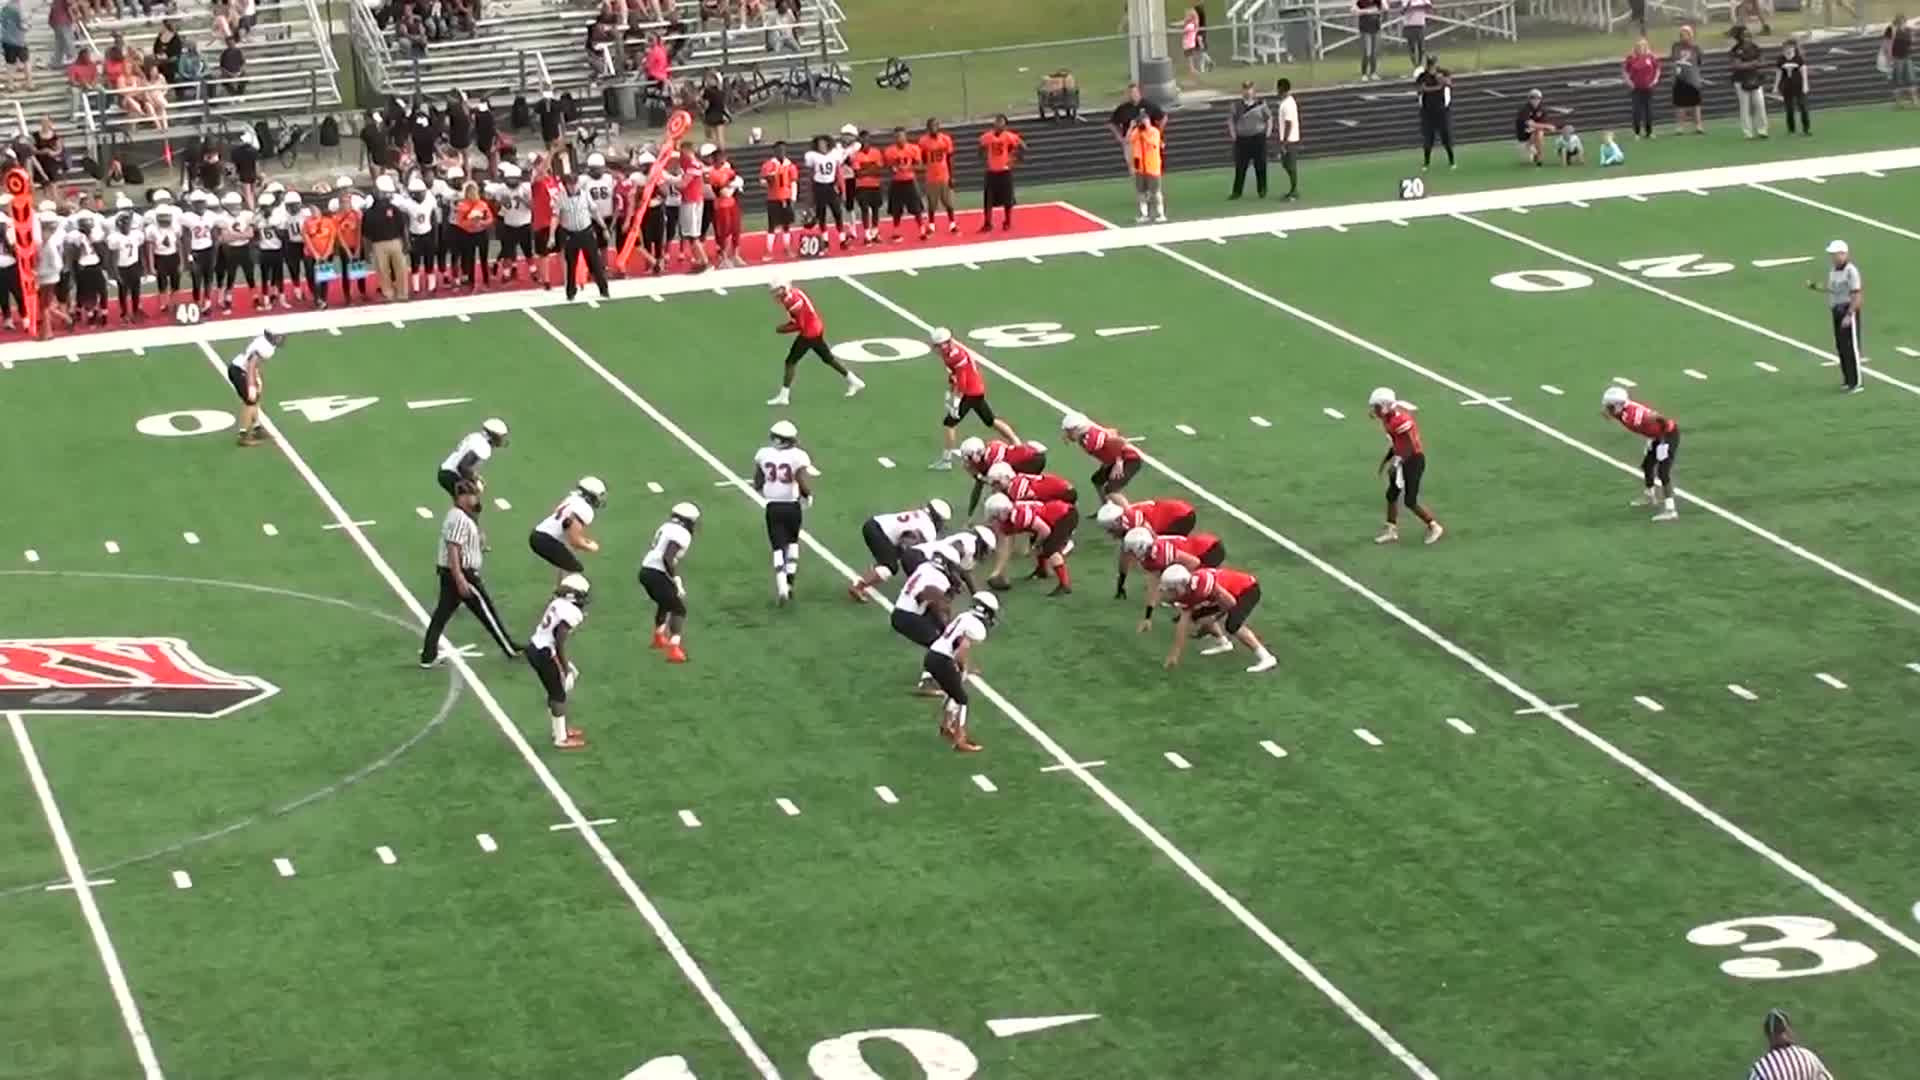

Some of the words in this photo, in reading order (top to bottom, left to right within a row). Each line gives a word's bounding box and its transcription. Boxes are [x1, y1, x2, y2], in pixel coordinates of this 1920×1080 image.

[1402, 178, 1424, 197] 20
[800, 237, 819, 255] 30
[176, 304, 200, 324] 40
[764, 461, 793, 483] 33
